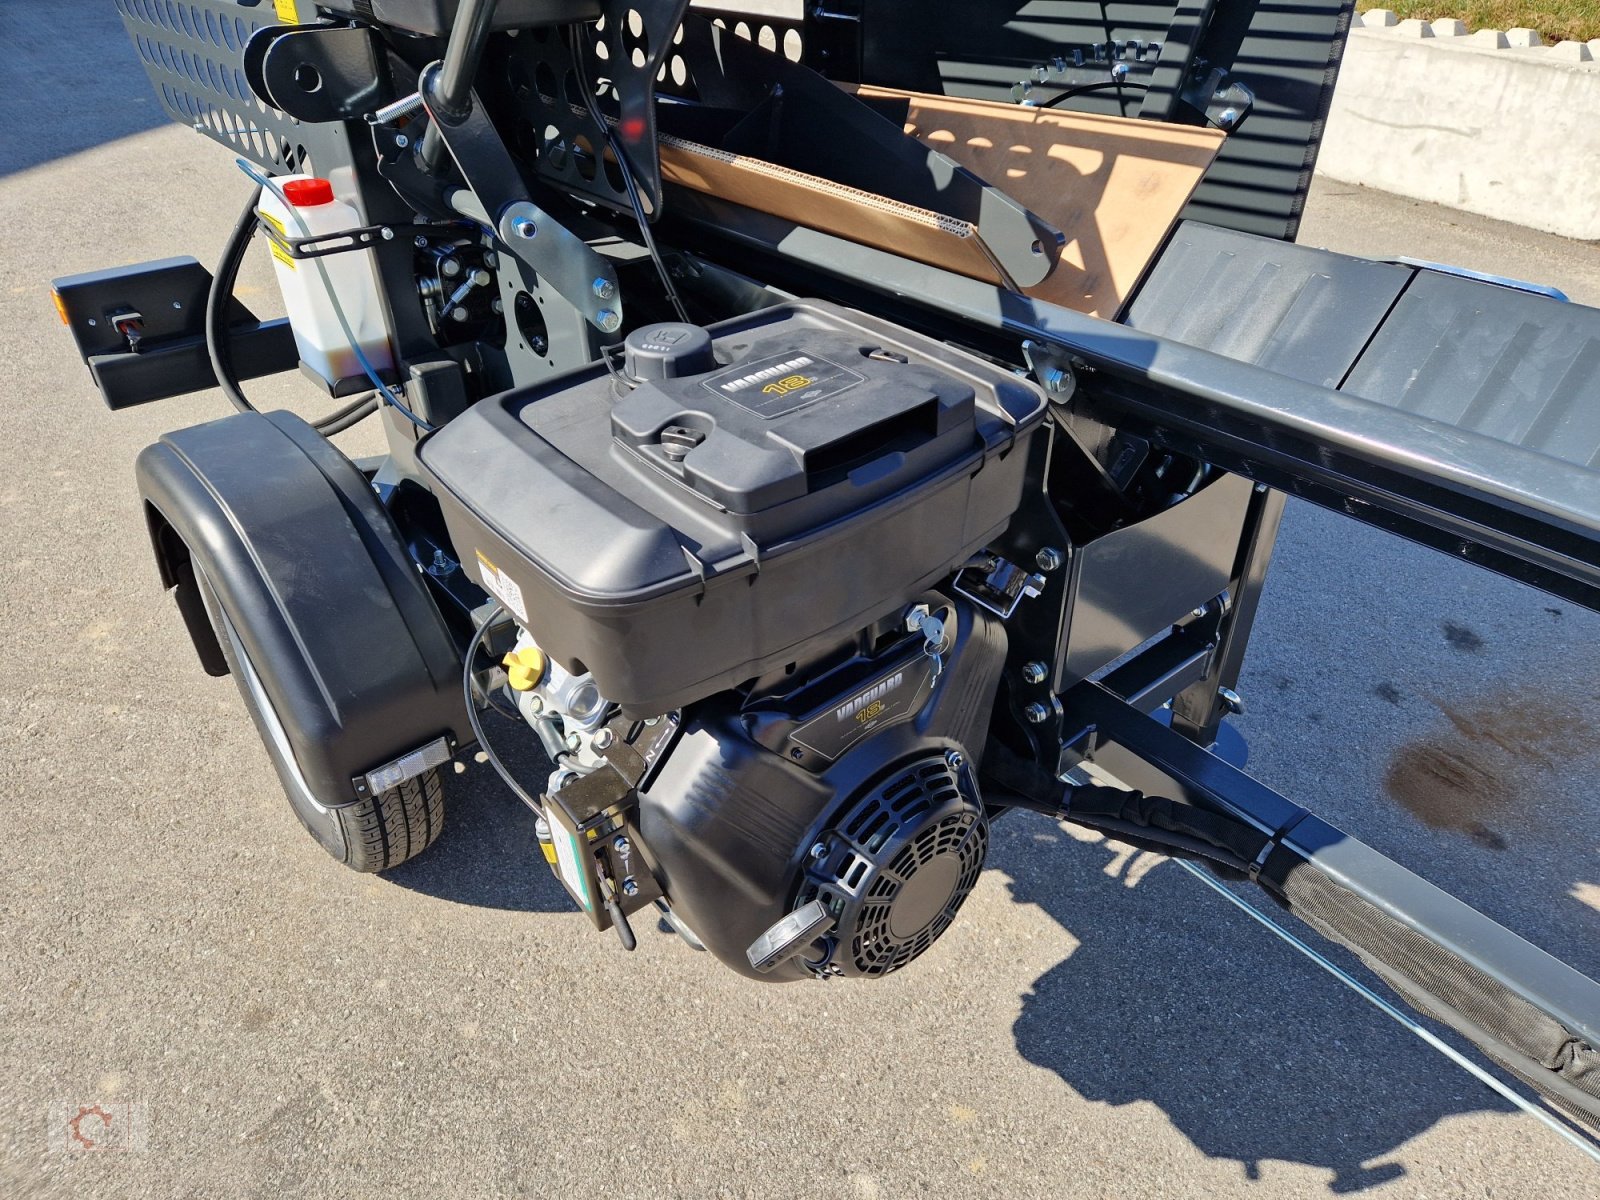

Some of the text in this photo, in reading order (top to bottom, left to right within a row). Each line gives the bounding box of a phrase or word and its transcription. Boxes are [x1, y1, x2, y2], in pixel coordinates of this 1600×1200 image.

[720, 356, 815, 393] VANGUARD
[762, 375, 811, 395] 18
[836, 672, 903, 722] VANGUARD
[855, 700, 881, 723] 18
